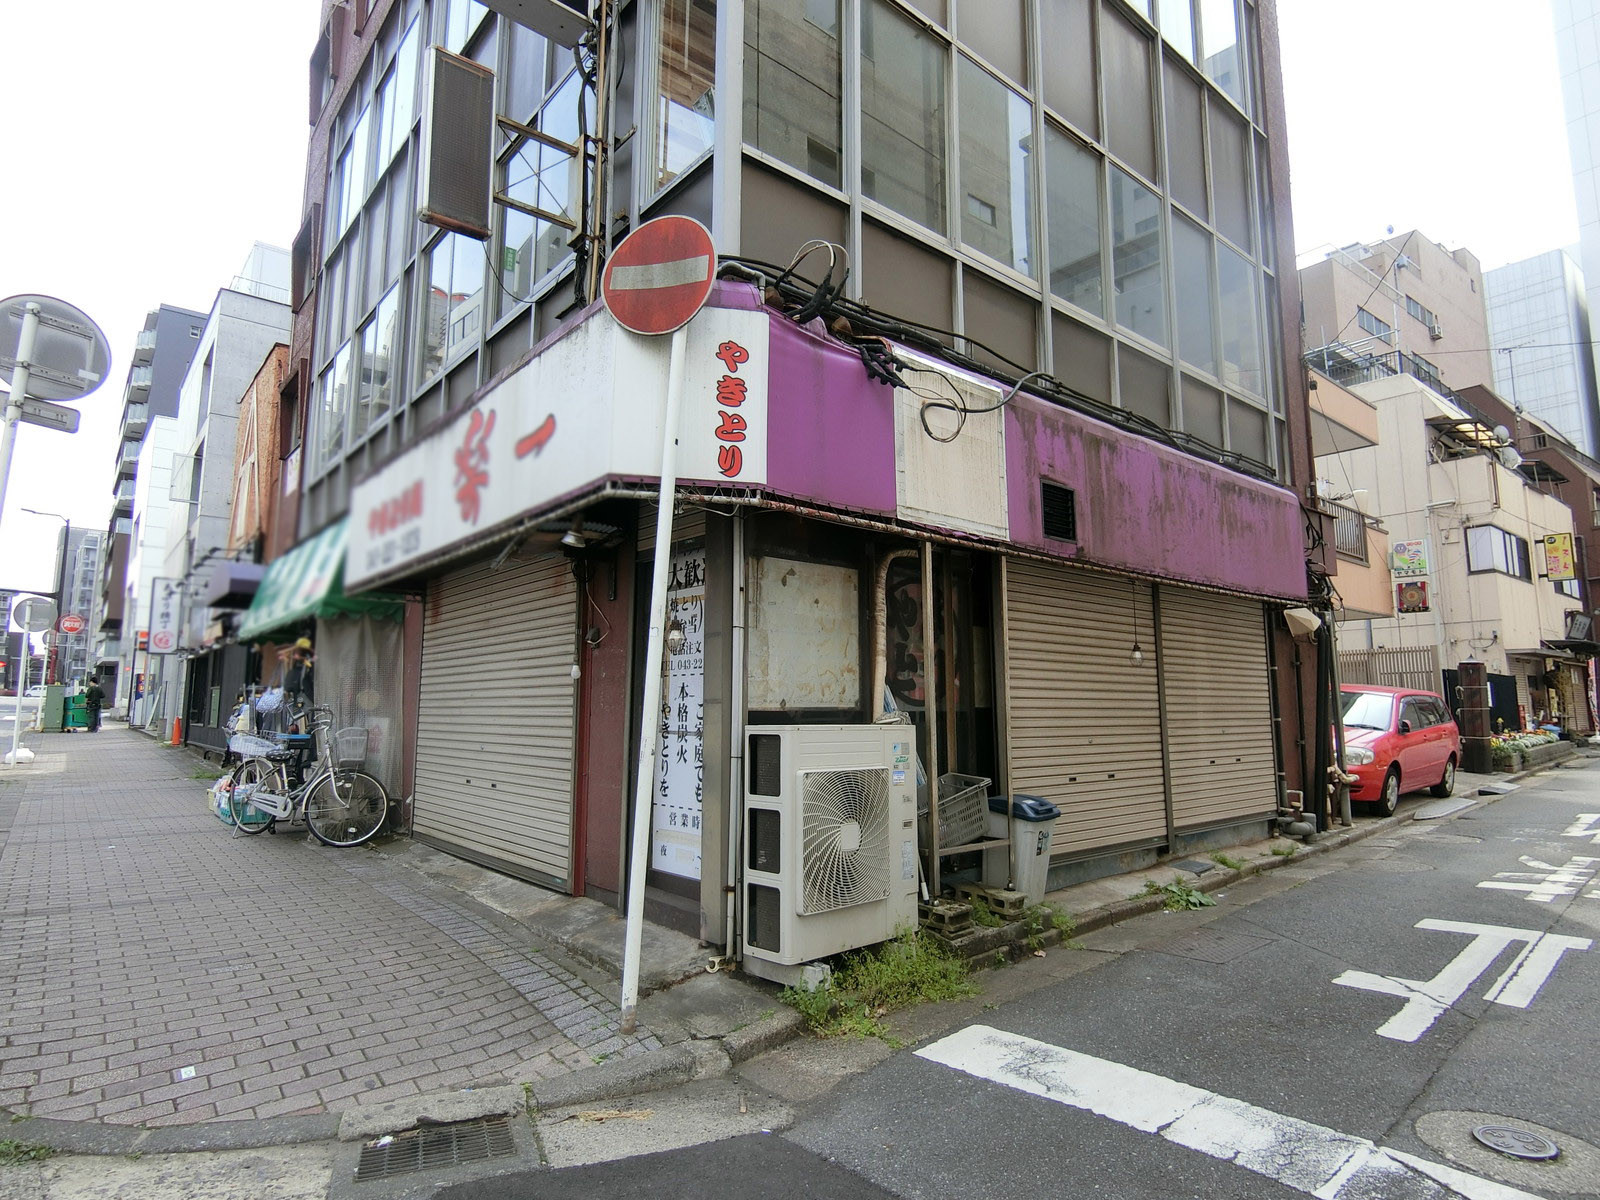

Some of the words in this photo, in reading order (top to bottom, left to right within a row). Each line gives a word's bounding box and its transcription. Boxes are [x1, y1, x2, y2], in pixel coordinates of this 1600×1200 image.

[715, 340, 749, 478] やきとり
[667, 558, 705, 592] 大歓
[660, 702, 671, 798] やきとりを
[676, 682, 689, 764] 本格炭火
[660, 844, 668, 857] 夜
